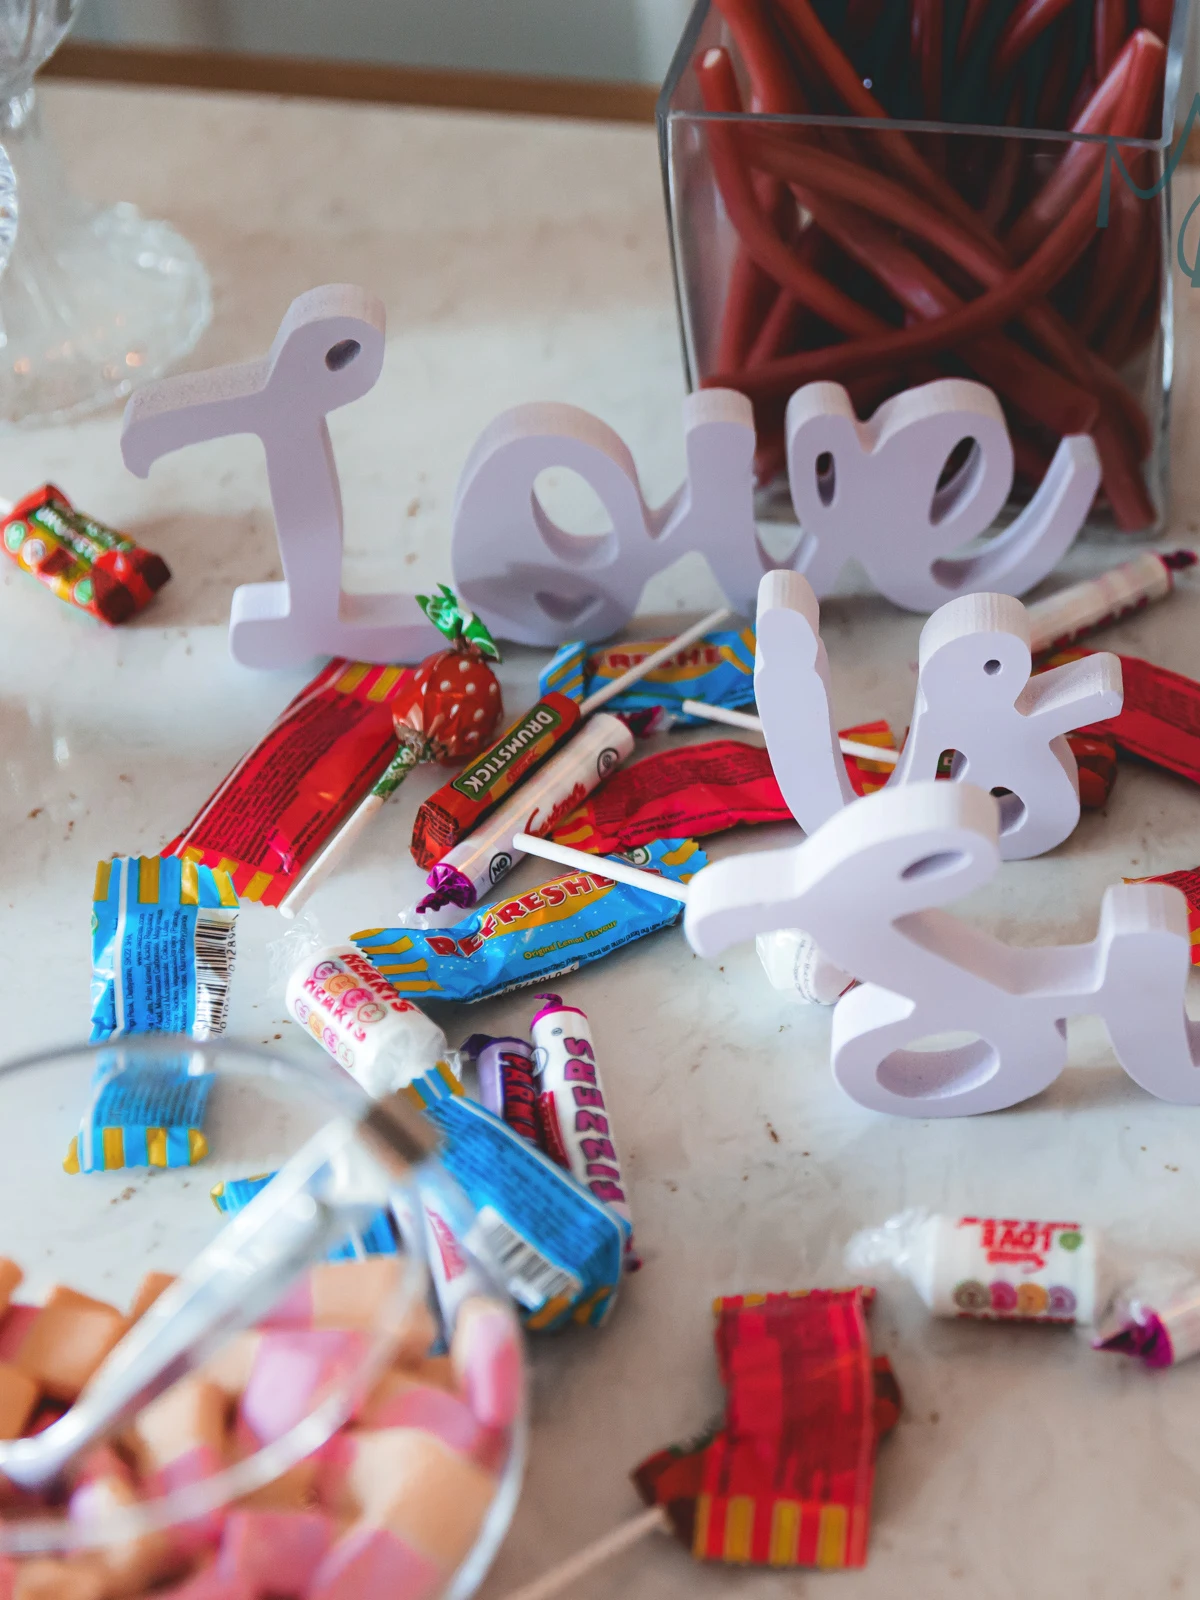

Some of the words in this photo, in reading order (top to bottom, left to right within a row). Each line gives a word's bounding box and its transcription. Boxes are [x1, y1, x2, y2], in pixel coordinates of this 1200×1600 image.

[120, 283, 1101, 670] Love
[464, 708, 555, 796] DRUMSTICK
[423, 864, 662, 958] REFRESHE
[523, 941, 557, 961] Original
[557, 934, 585, 950] Lemon
[585, 919, 618, 942] Flavour
[563, 1037, 625, 1203] FIZZERS
